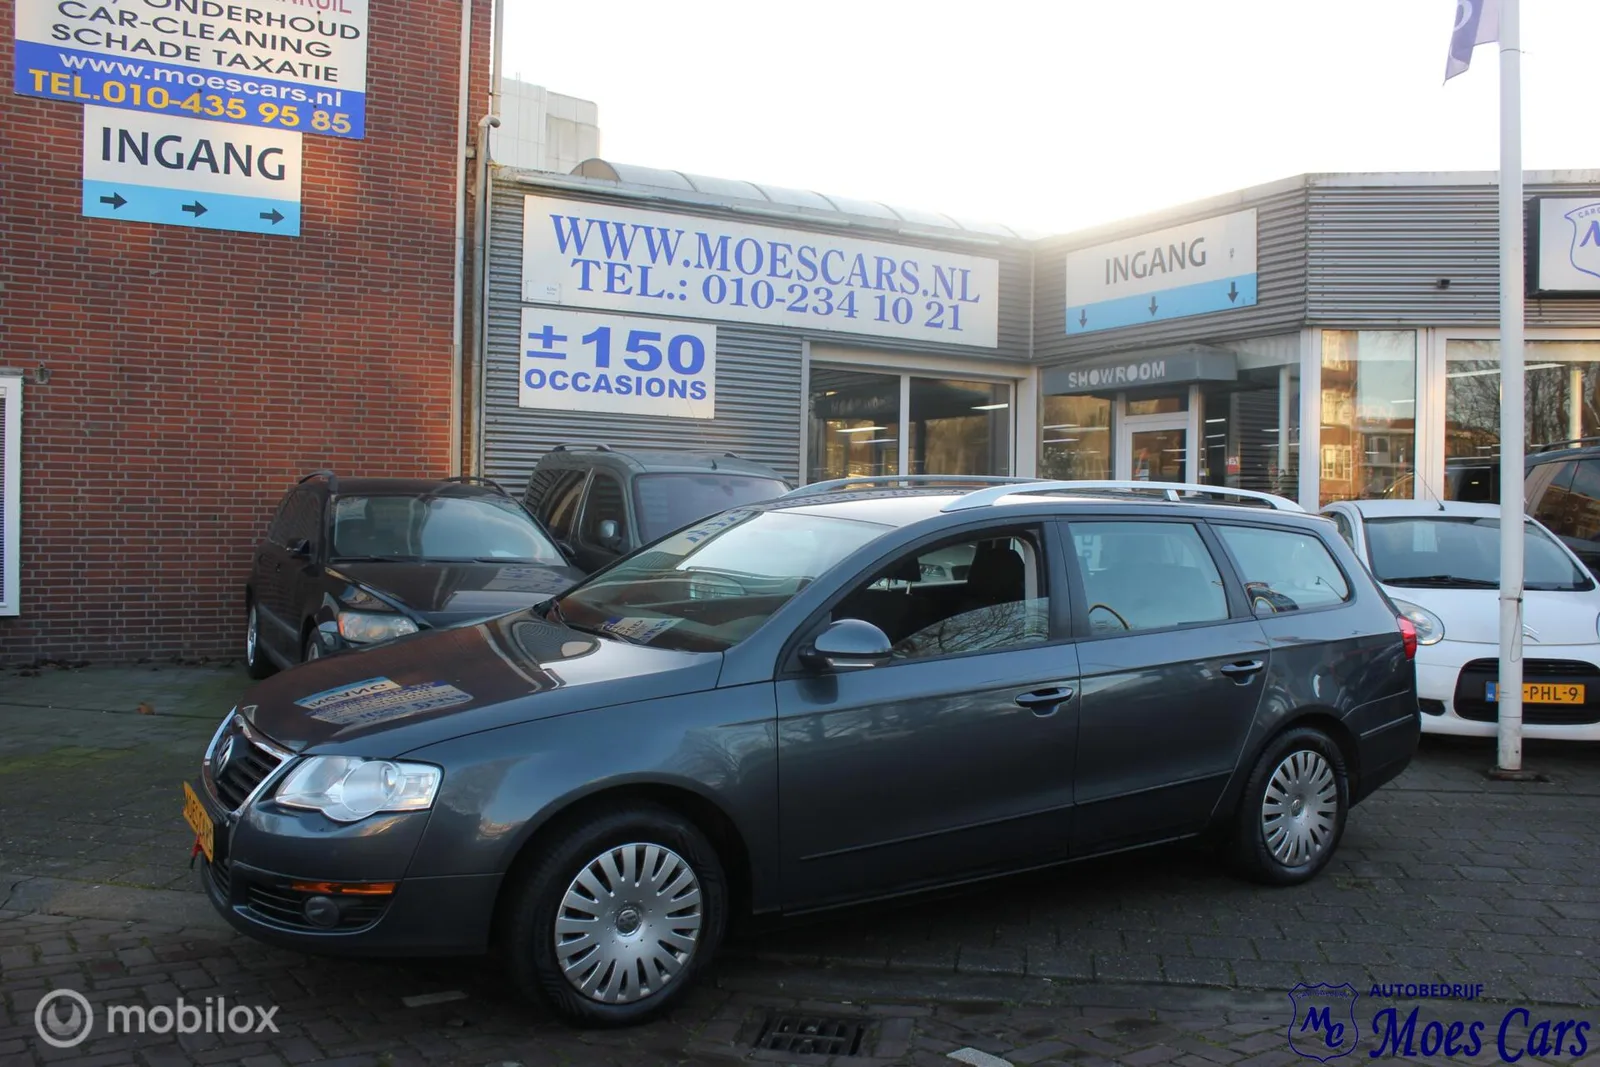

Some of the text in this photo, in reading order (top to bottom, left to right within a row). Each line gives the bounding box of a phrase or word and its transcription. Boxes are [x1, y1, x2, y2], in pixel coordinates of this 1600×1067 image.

[58, 1, 332, 58] CAR-CLEANING
[143, 0, 360, 39] ONDERHOUD
[51, 24, 339, 83] SCHADE TAXATIE
[59, 53, 342, 108] www.moescars.nl
[28, 68, 351, 134] TEL.010-435 95 85
[102, 126, 285, 181] INGANG
[549, 214, 980, 303] WWW.MOESCARS.NL
[1105, 237, 1206, 286] INGANG
[571, 258, 964, 331] TEL.: 010-234 10 21
[524, 368, 707, 400] OCCASIONS
[1068, 360, 1166, 388] SHOWROOM
[1523, 686, 1579, 701] -PHL-9
